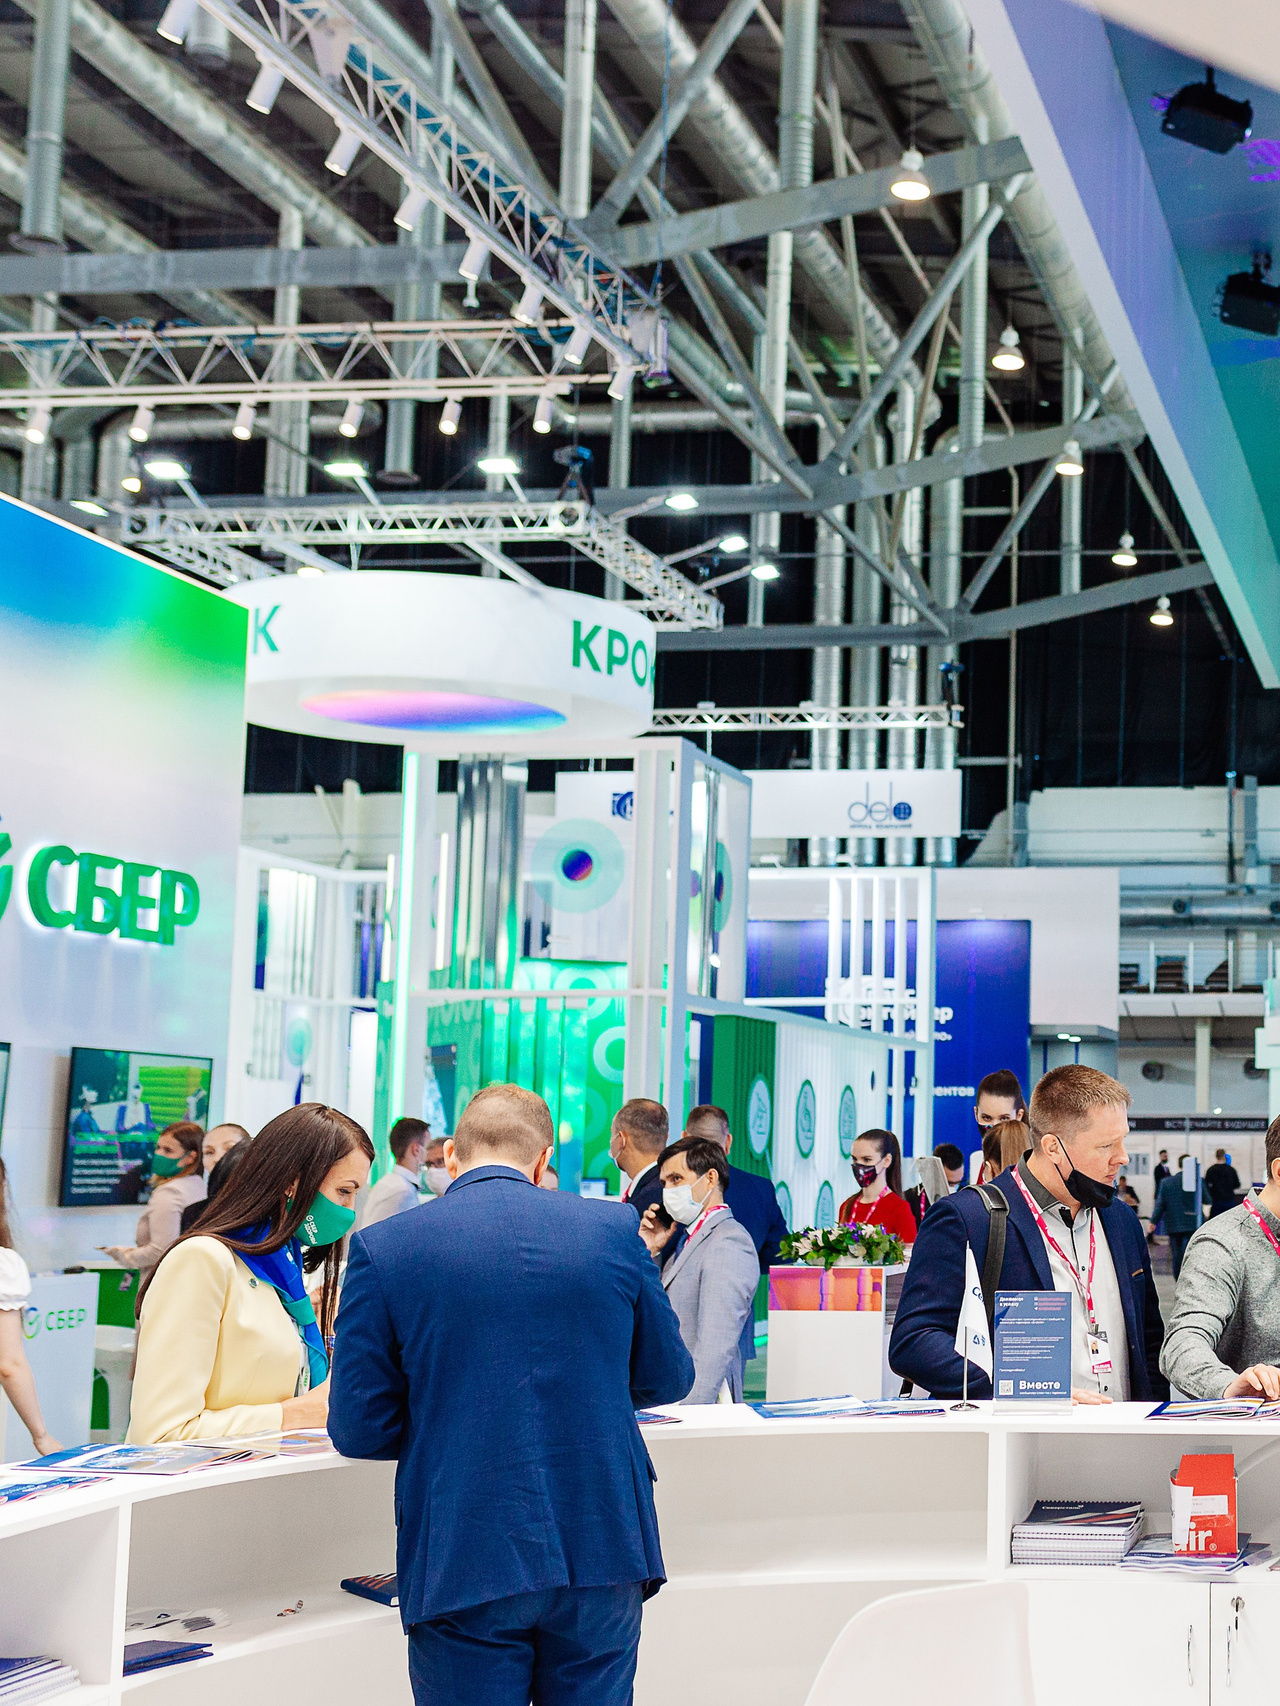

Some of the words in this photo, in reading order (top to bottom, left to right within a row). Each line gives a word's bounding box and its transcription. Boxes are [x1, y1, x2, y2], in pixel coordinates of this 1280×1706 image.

[28, 845, 200, 945] СБЕР
[45, 1308, 87, 1331] СБЕР
[1019, 1380, 1061, 1390] Вместе
